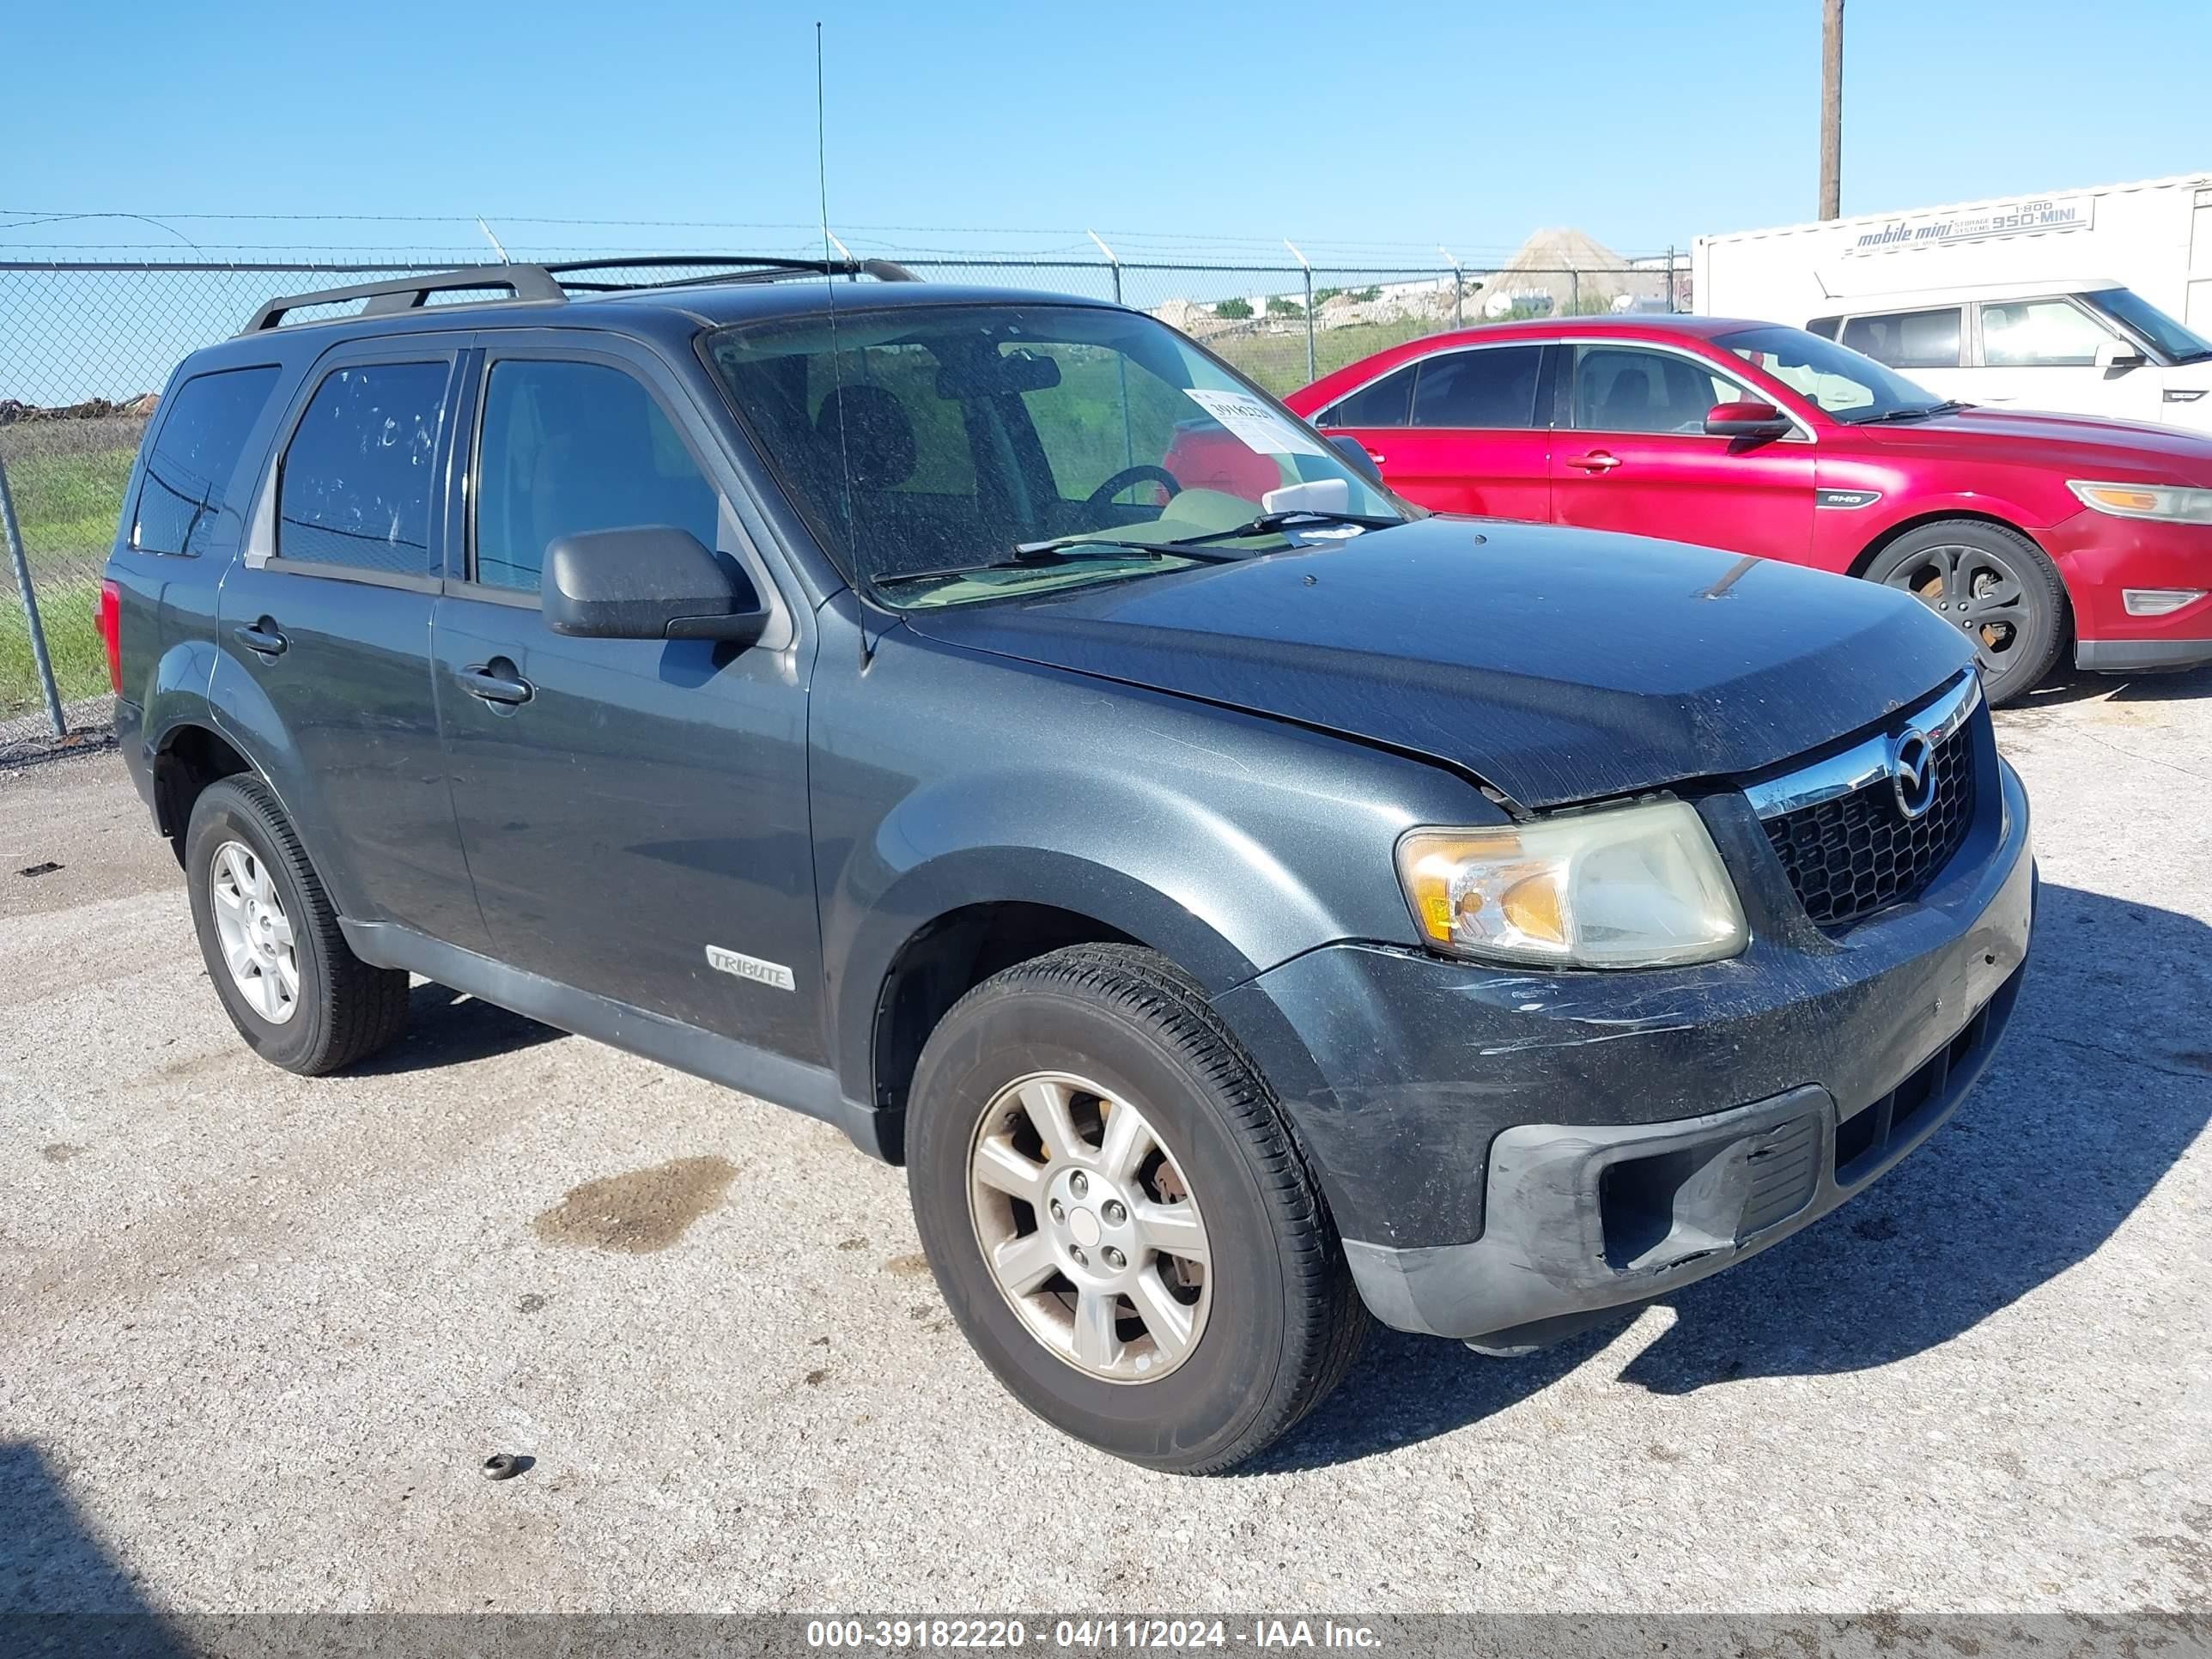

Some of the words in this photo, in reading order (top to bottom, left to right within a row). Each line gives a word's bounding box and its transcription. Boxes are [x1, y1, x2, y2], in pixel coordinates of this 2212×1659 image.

[1992, 207, 2075, 228] 950-MINI
[2015, 202, 2052, 214] 1-800
[1857, 222, 1912, 246] mobile
[1915, 220, 1954, 240] mini
[1827, 495, 1862, 503] SHO
[711, 951, 788, 987] TRIBUTE
